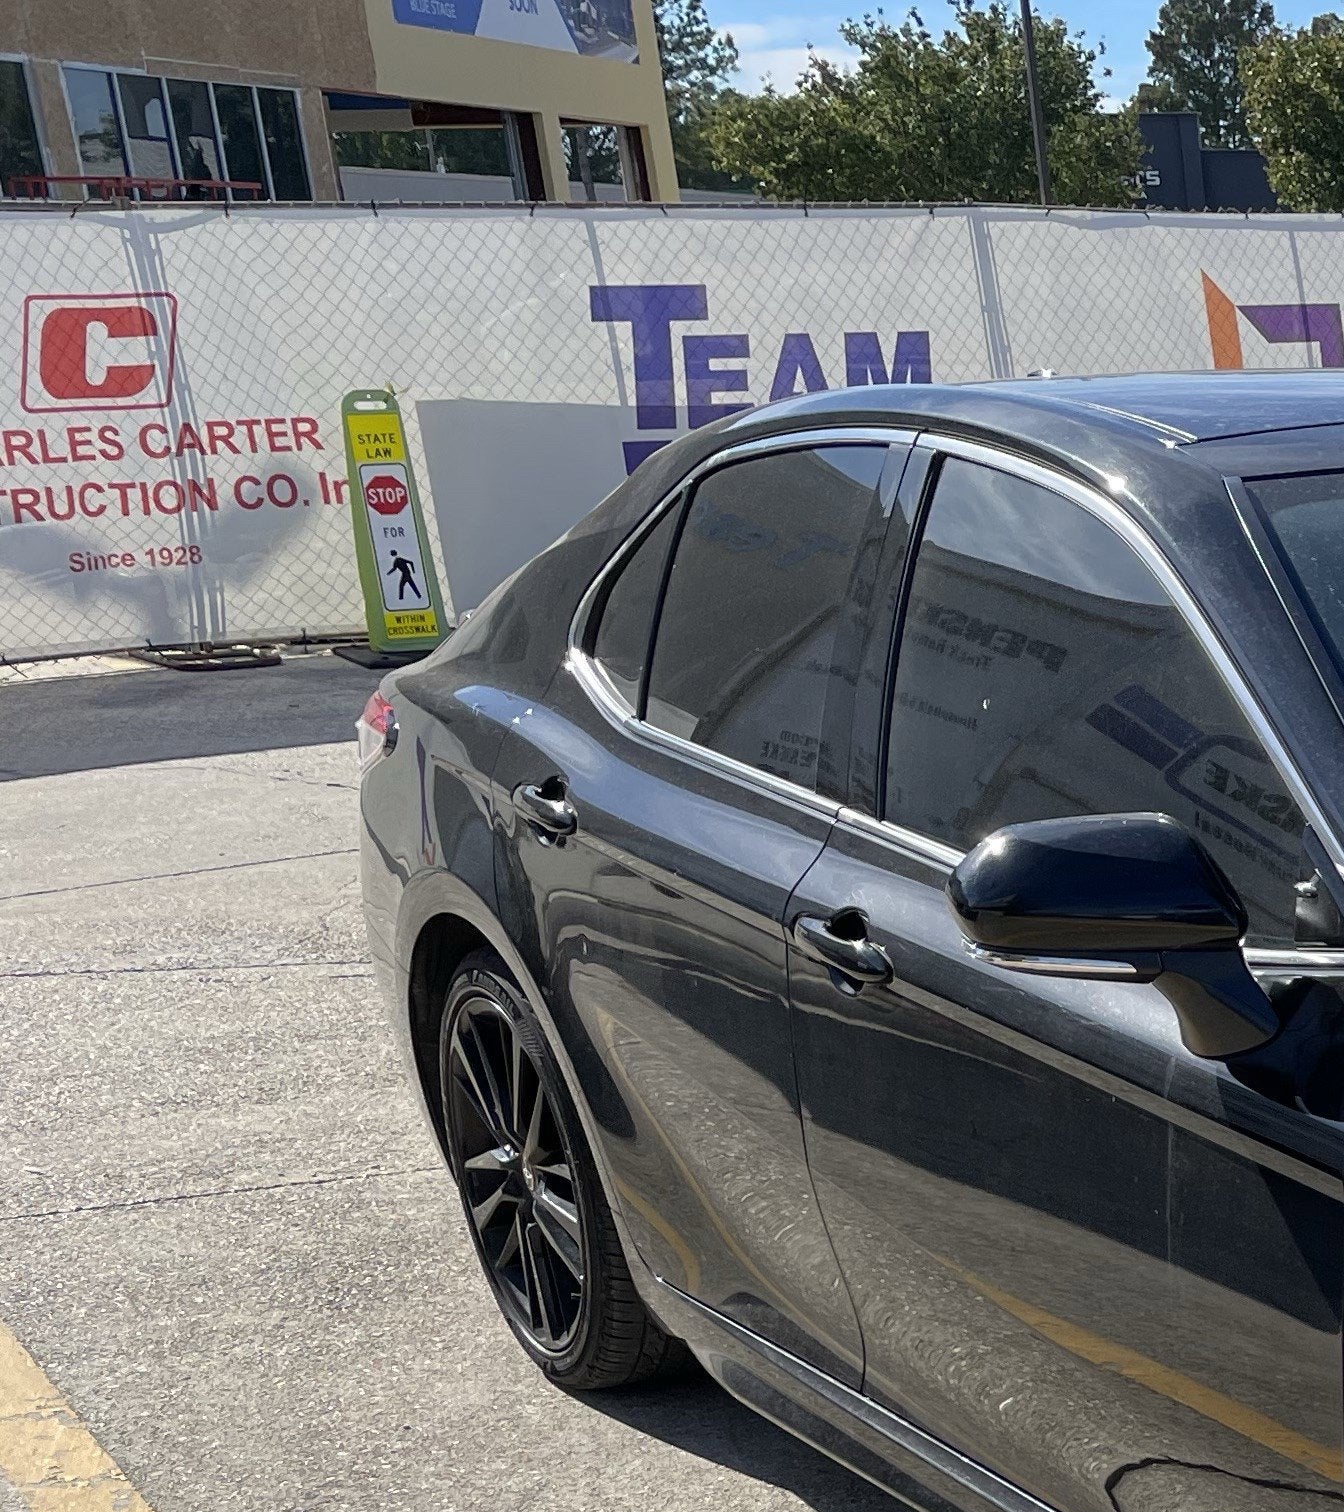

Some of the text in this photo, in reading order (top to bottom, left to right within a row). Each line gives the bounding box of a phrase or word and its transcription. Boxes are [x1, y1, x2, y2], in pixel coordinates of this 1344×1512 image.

[589, 283, 931, 430] TEAM
[0, 416, 325, 467] RLES CARTER
[357, 433, 396, 445] STATE
[365, 447, 392, 459] LAW
[0, 477, 219, 526] RUCTION
[233, 474, 310, 511] CO.
[367, 487, 406, 505] STOP
[383, 526, 406, 539] FOR
[69, 544, 203, 573] Since 1928
[394, 613, 426, 624] WITHIN
[387, 625, 438, 636] CROSSWALK
